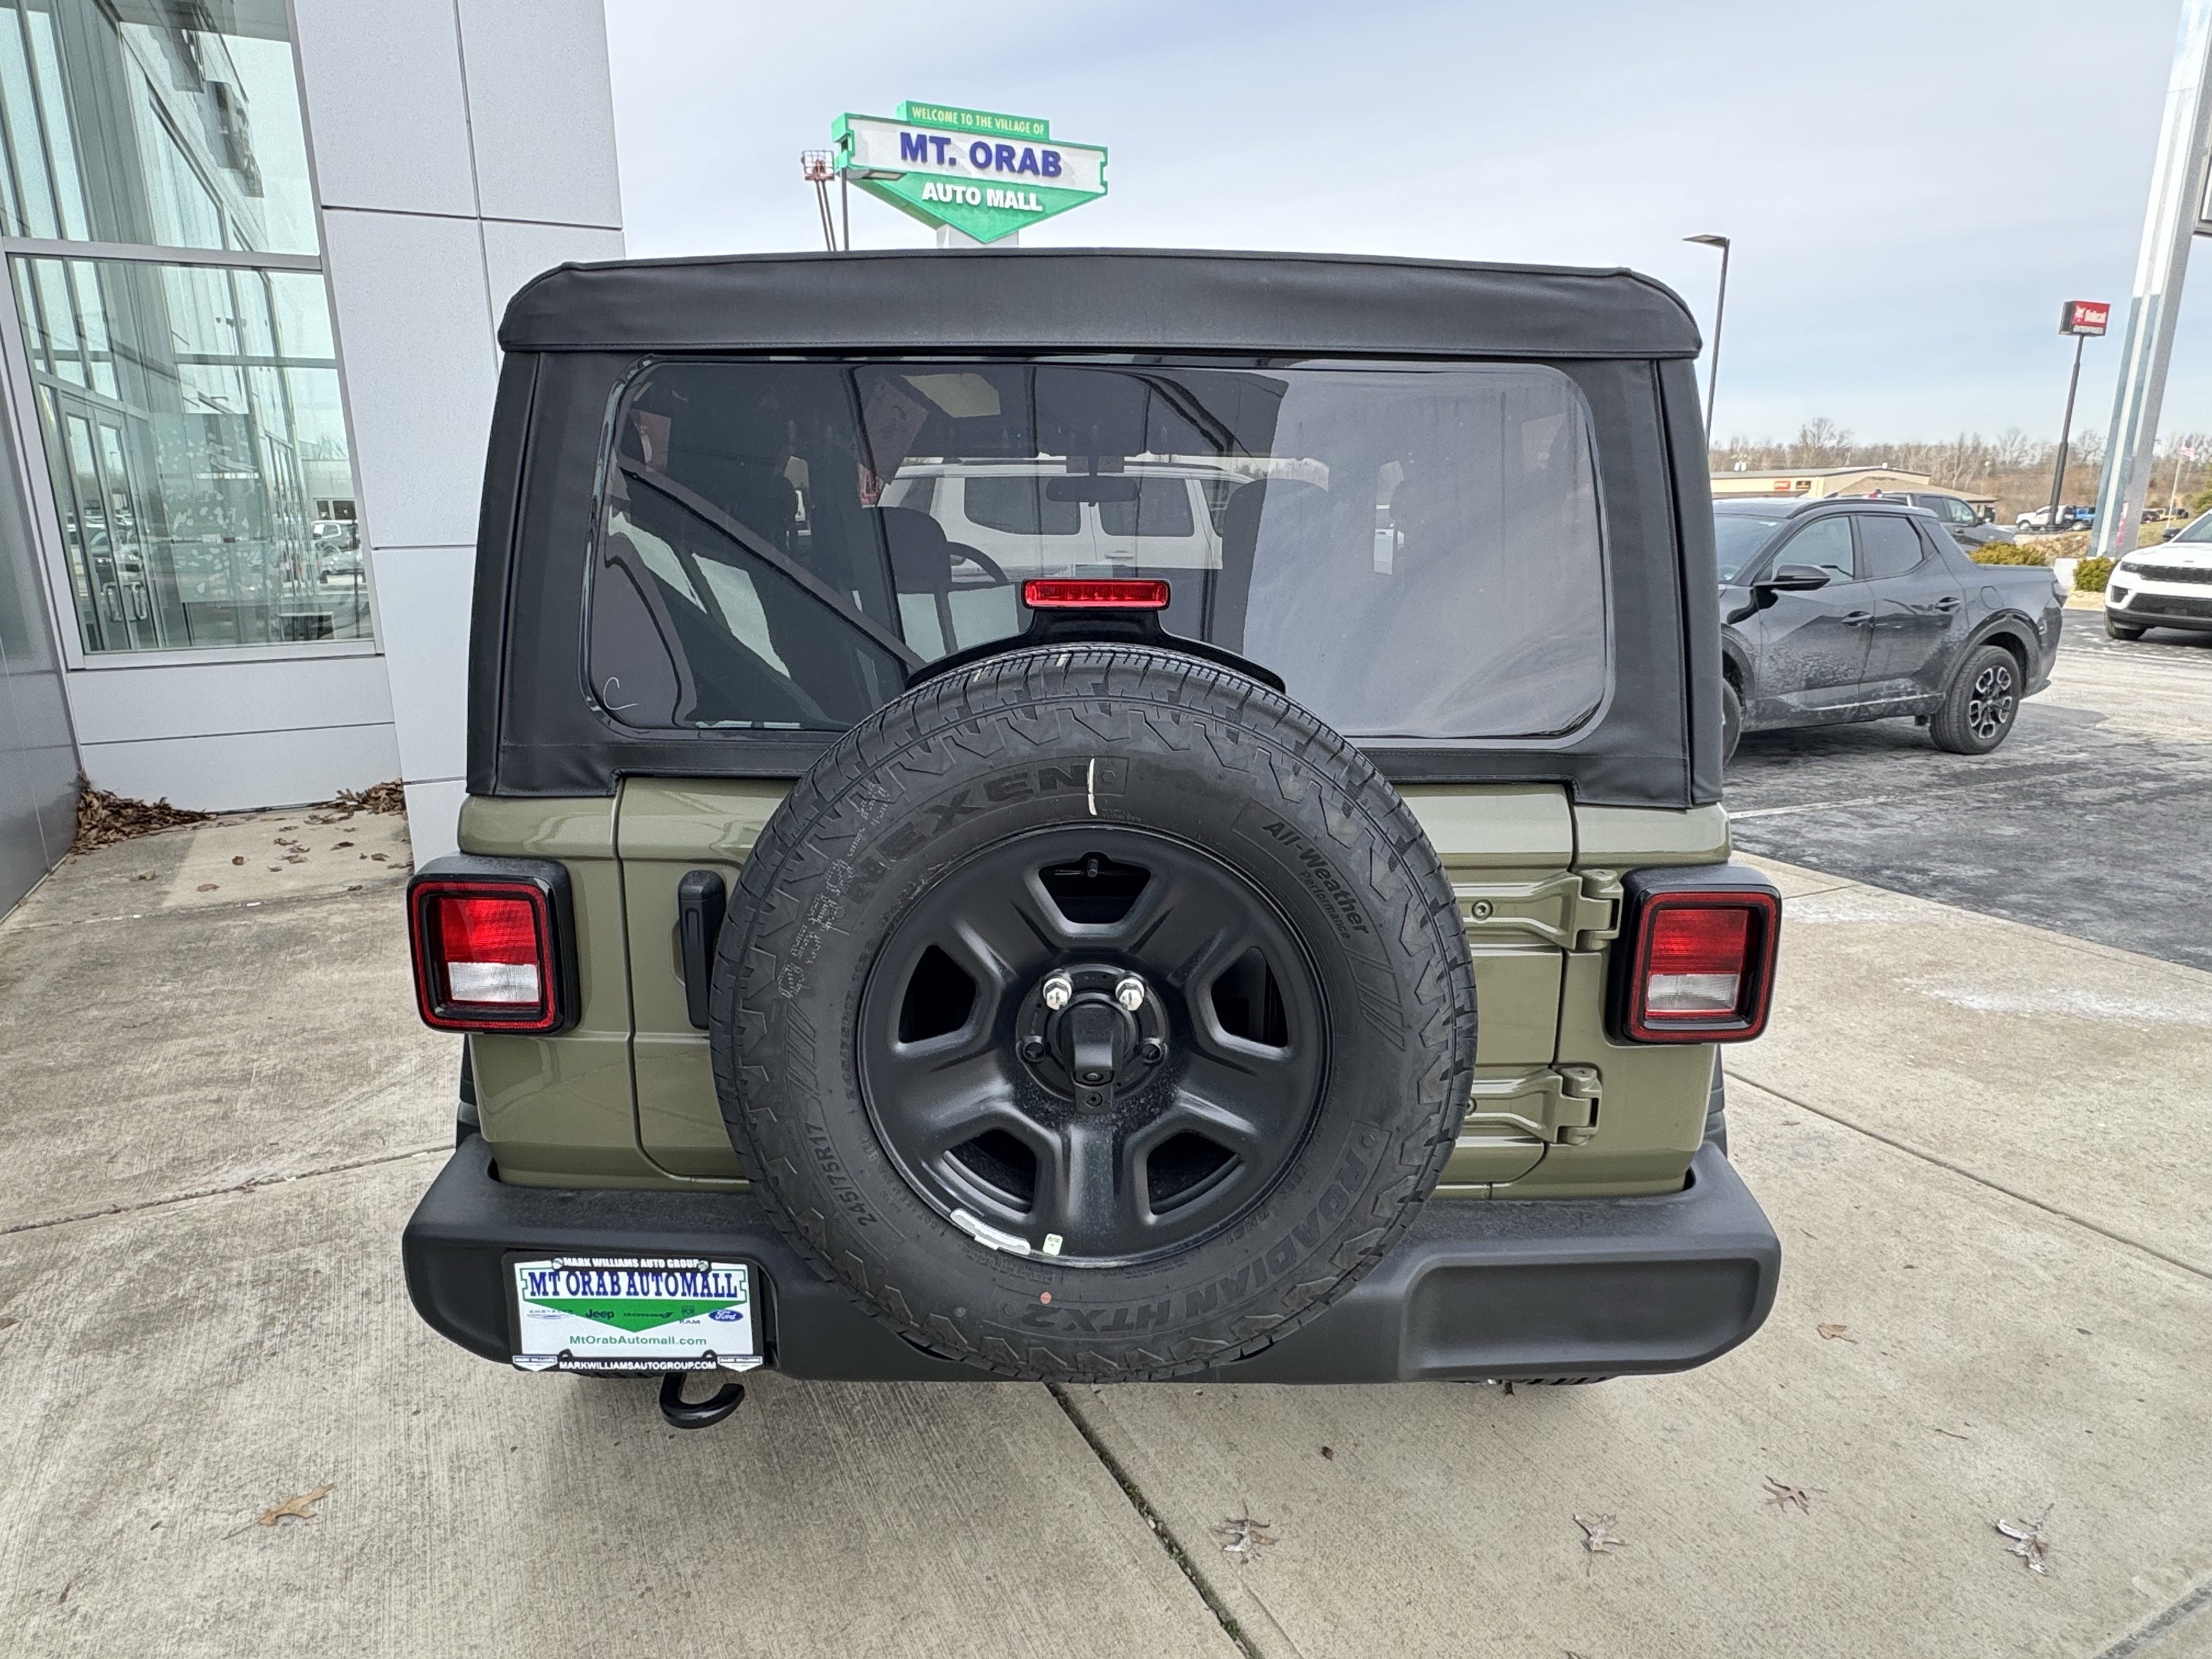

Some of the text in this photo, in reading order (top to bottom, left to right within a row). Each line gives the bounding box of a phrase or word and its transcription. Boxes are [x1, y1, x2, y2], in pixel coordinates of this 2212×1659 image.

[912, 106, 1045, 135] WELCOME TO THE VILLAGE OF
[900, 132, 1062, 178] MT. ORAB
[922, 182, 1043, 212] AUTO MALL
[845, 764, 1088, 905] NEXEN
[1262, 822, 1369, 934] All-Weather
[1298, 871, 1351, 940] Performance
[805, 1122, 878, 1227] 245/75R17
[1022, 1148, 1368, 1333] ROADIAN HTX2
[563, 1257, 699, 1268] MARK WILLIAMS AUTO GROUP
[528, 1271, 738, 1298] MT ORAB AUTOMALL
[585, 1308, 614, 1320] Jeep
[714, 1309, 737, 1321] Ford
[569, 1335, 707, 1346] MtOrabAutomall.com
[559, 1361, 717, 1370] MARKWILLIAMSAUTOGROUP.COM
